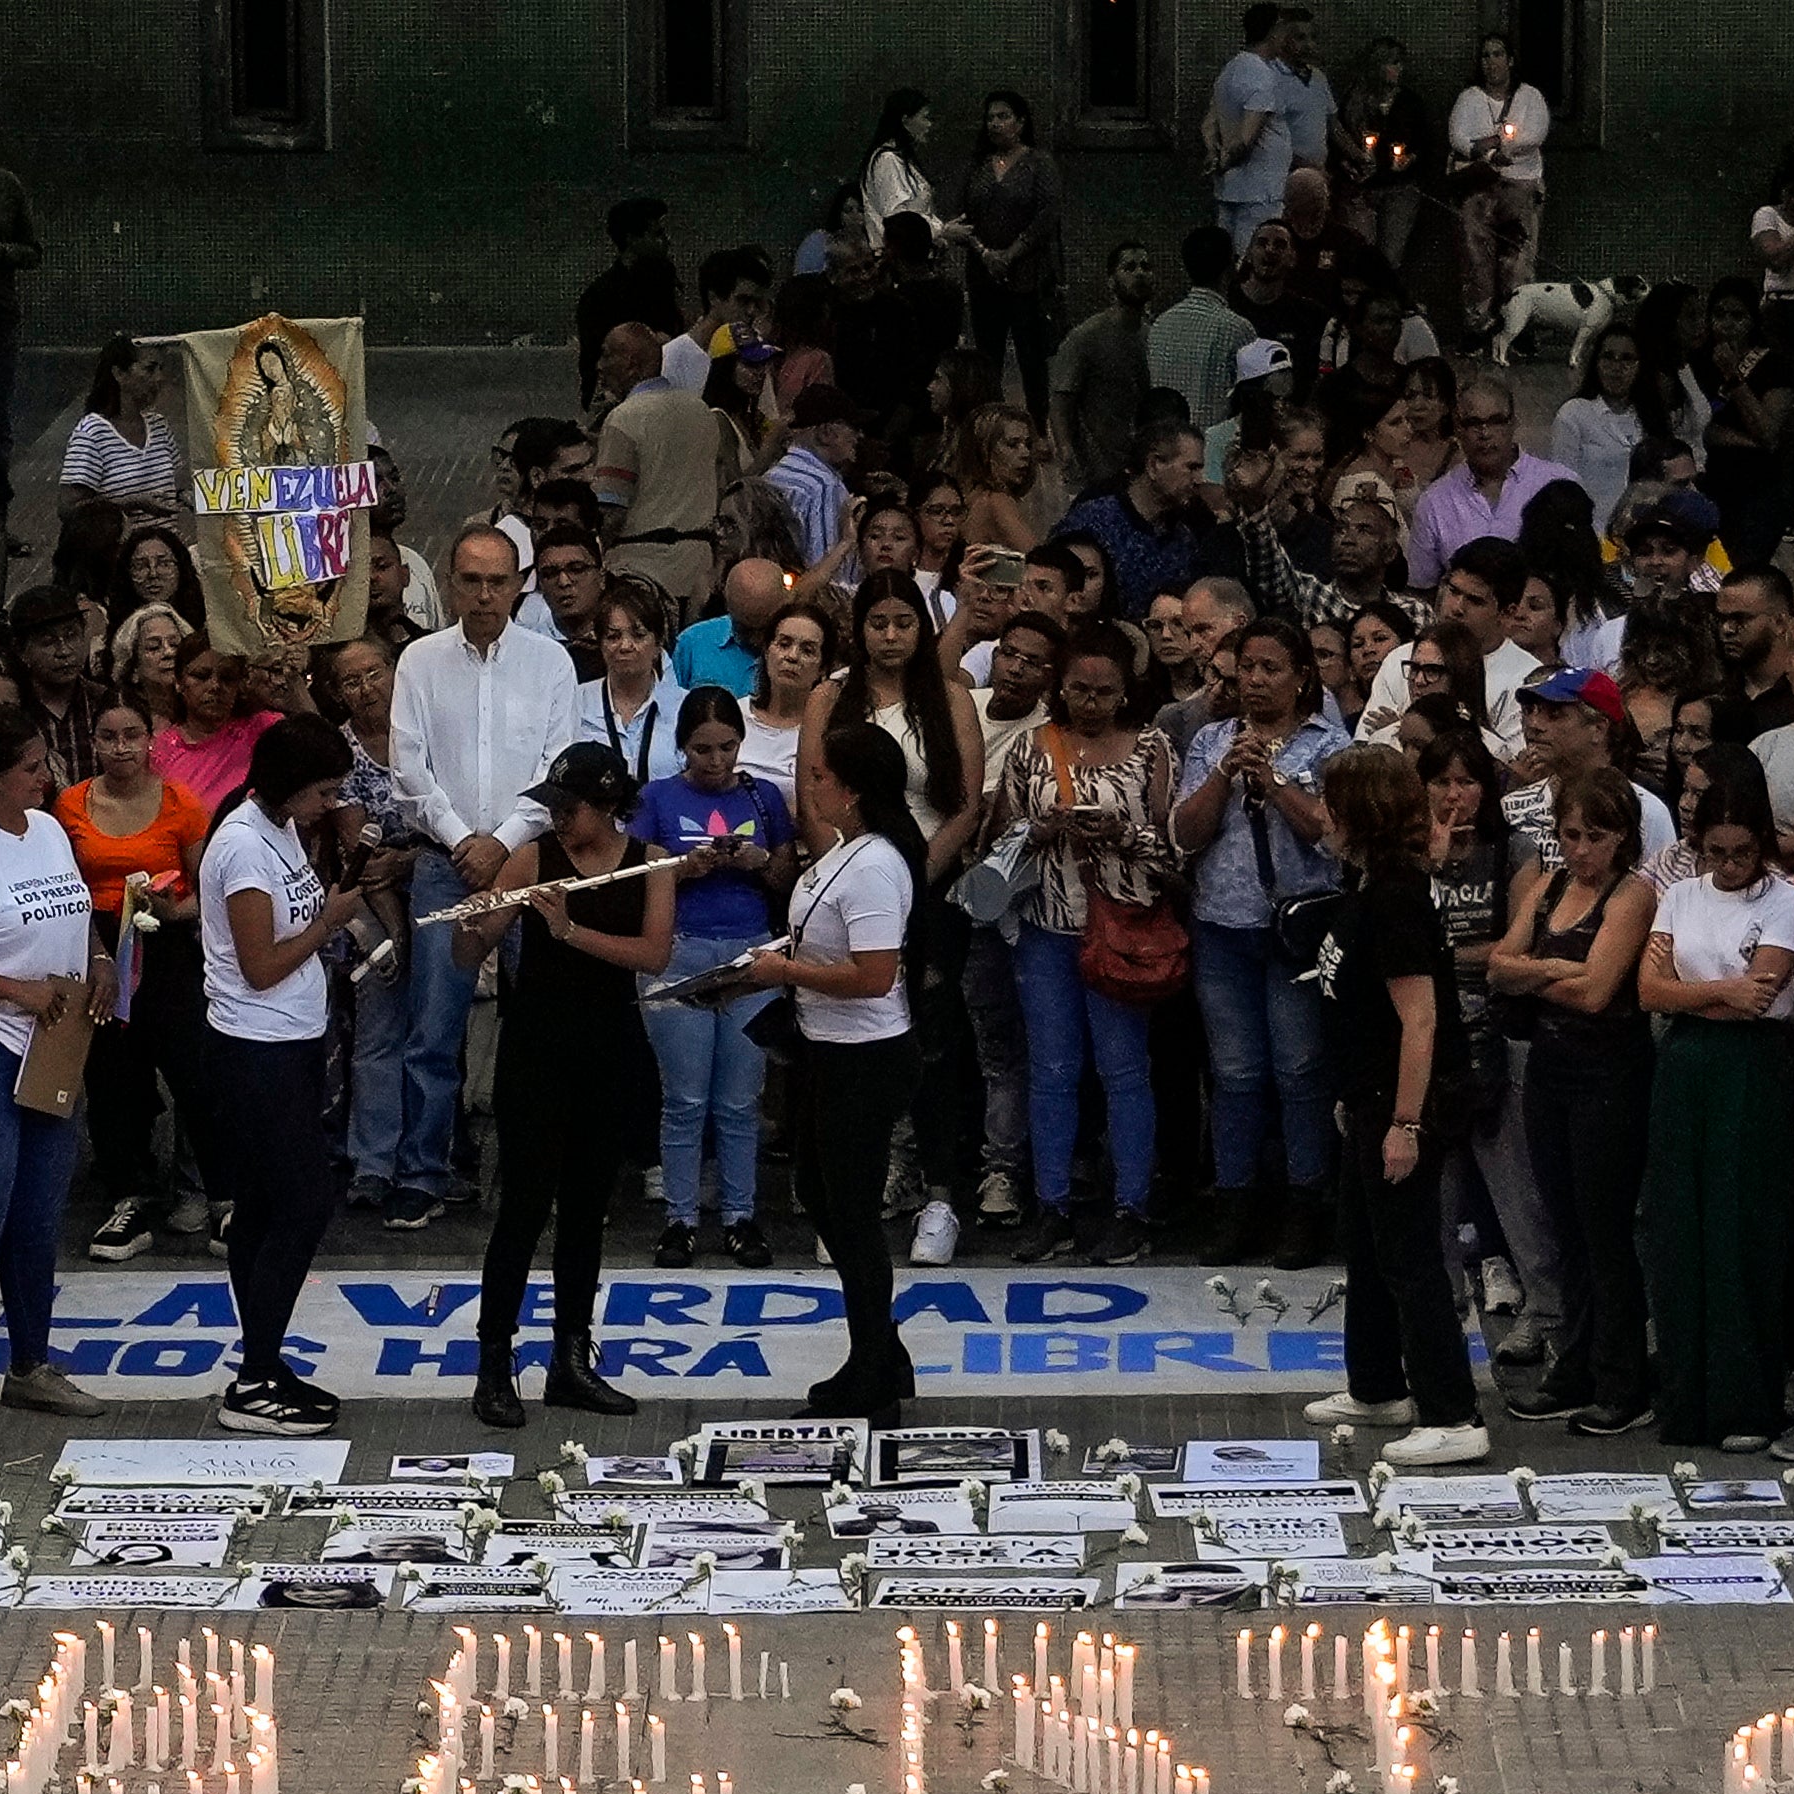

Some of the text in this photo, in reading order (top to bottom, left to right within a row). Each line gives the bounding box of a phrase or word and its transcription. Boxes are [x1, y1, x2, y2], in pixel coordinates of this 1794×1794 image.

[195, 464, 376, 510] VENEZUELA
[14, 889, 42, 906] LOS
[21, 897, 92, 925] POLÍTICOS
[338, 1281, 1148, 1327] VERDAD
